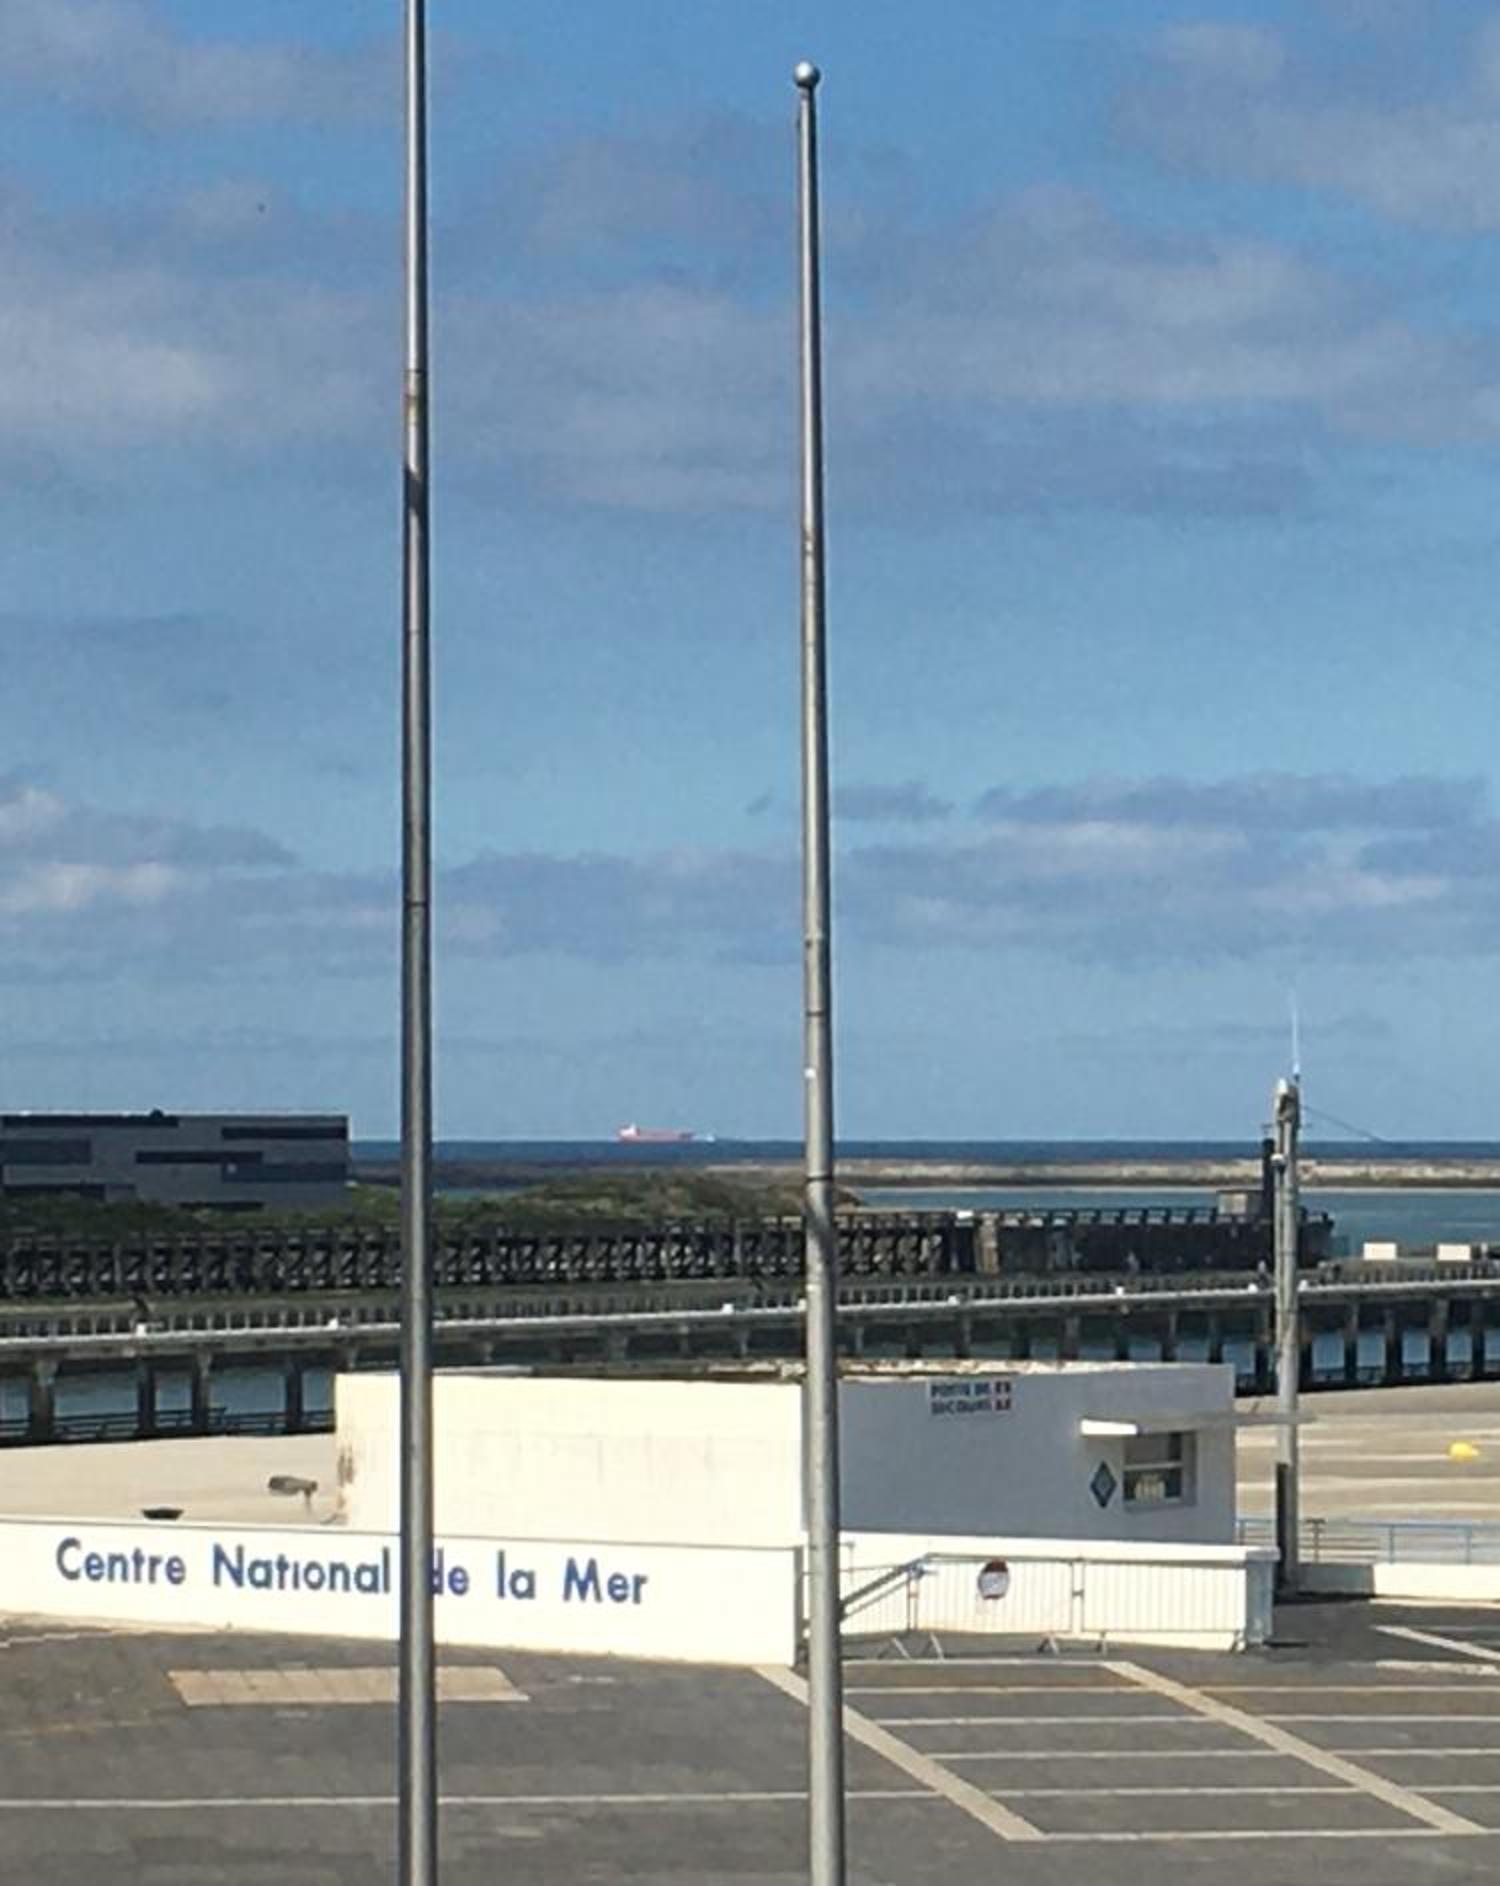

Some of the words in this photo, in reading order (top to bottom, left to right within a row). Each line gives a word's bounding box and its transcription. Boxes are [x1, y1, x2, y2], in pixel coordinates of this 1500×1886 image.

[56, 1537, 186, 1585] Centre
[213, 1544, 391, 1594] National
[497, 1550, 535, 1600] la
[563, 1557, 648, 1604] Mer
